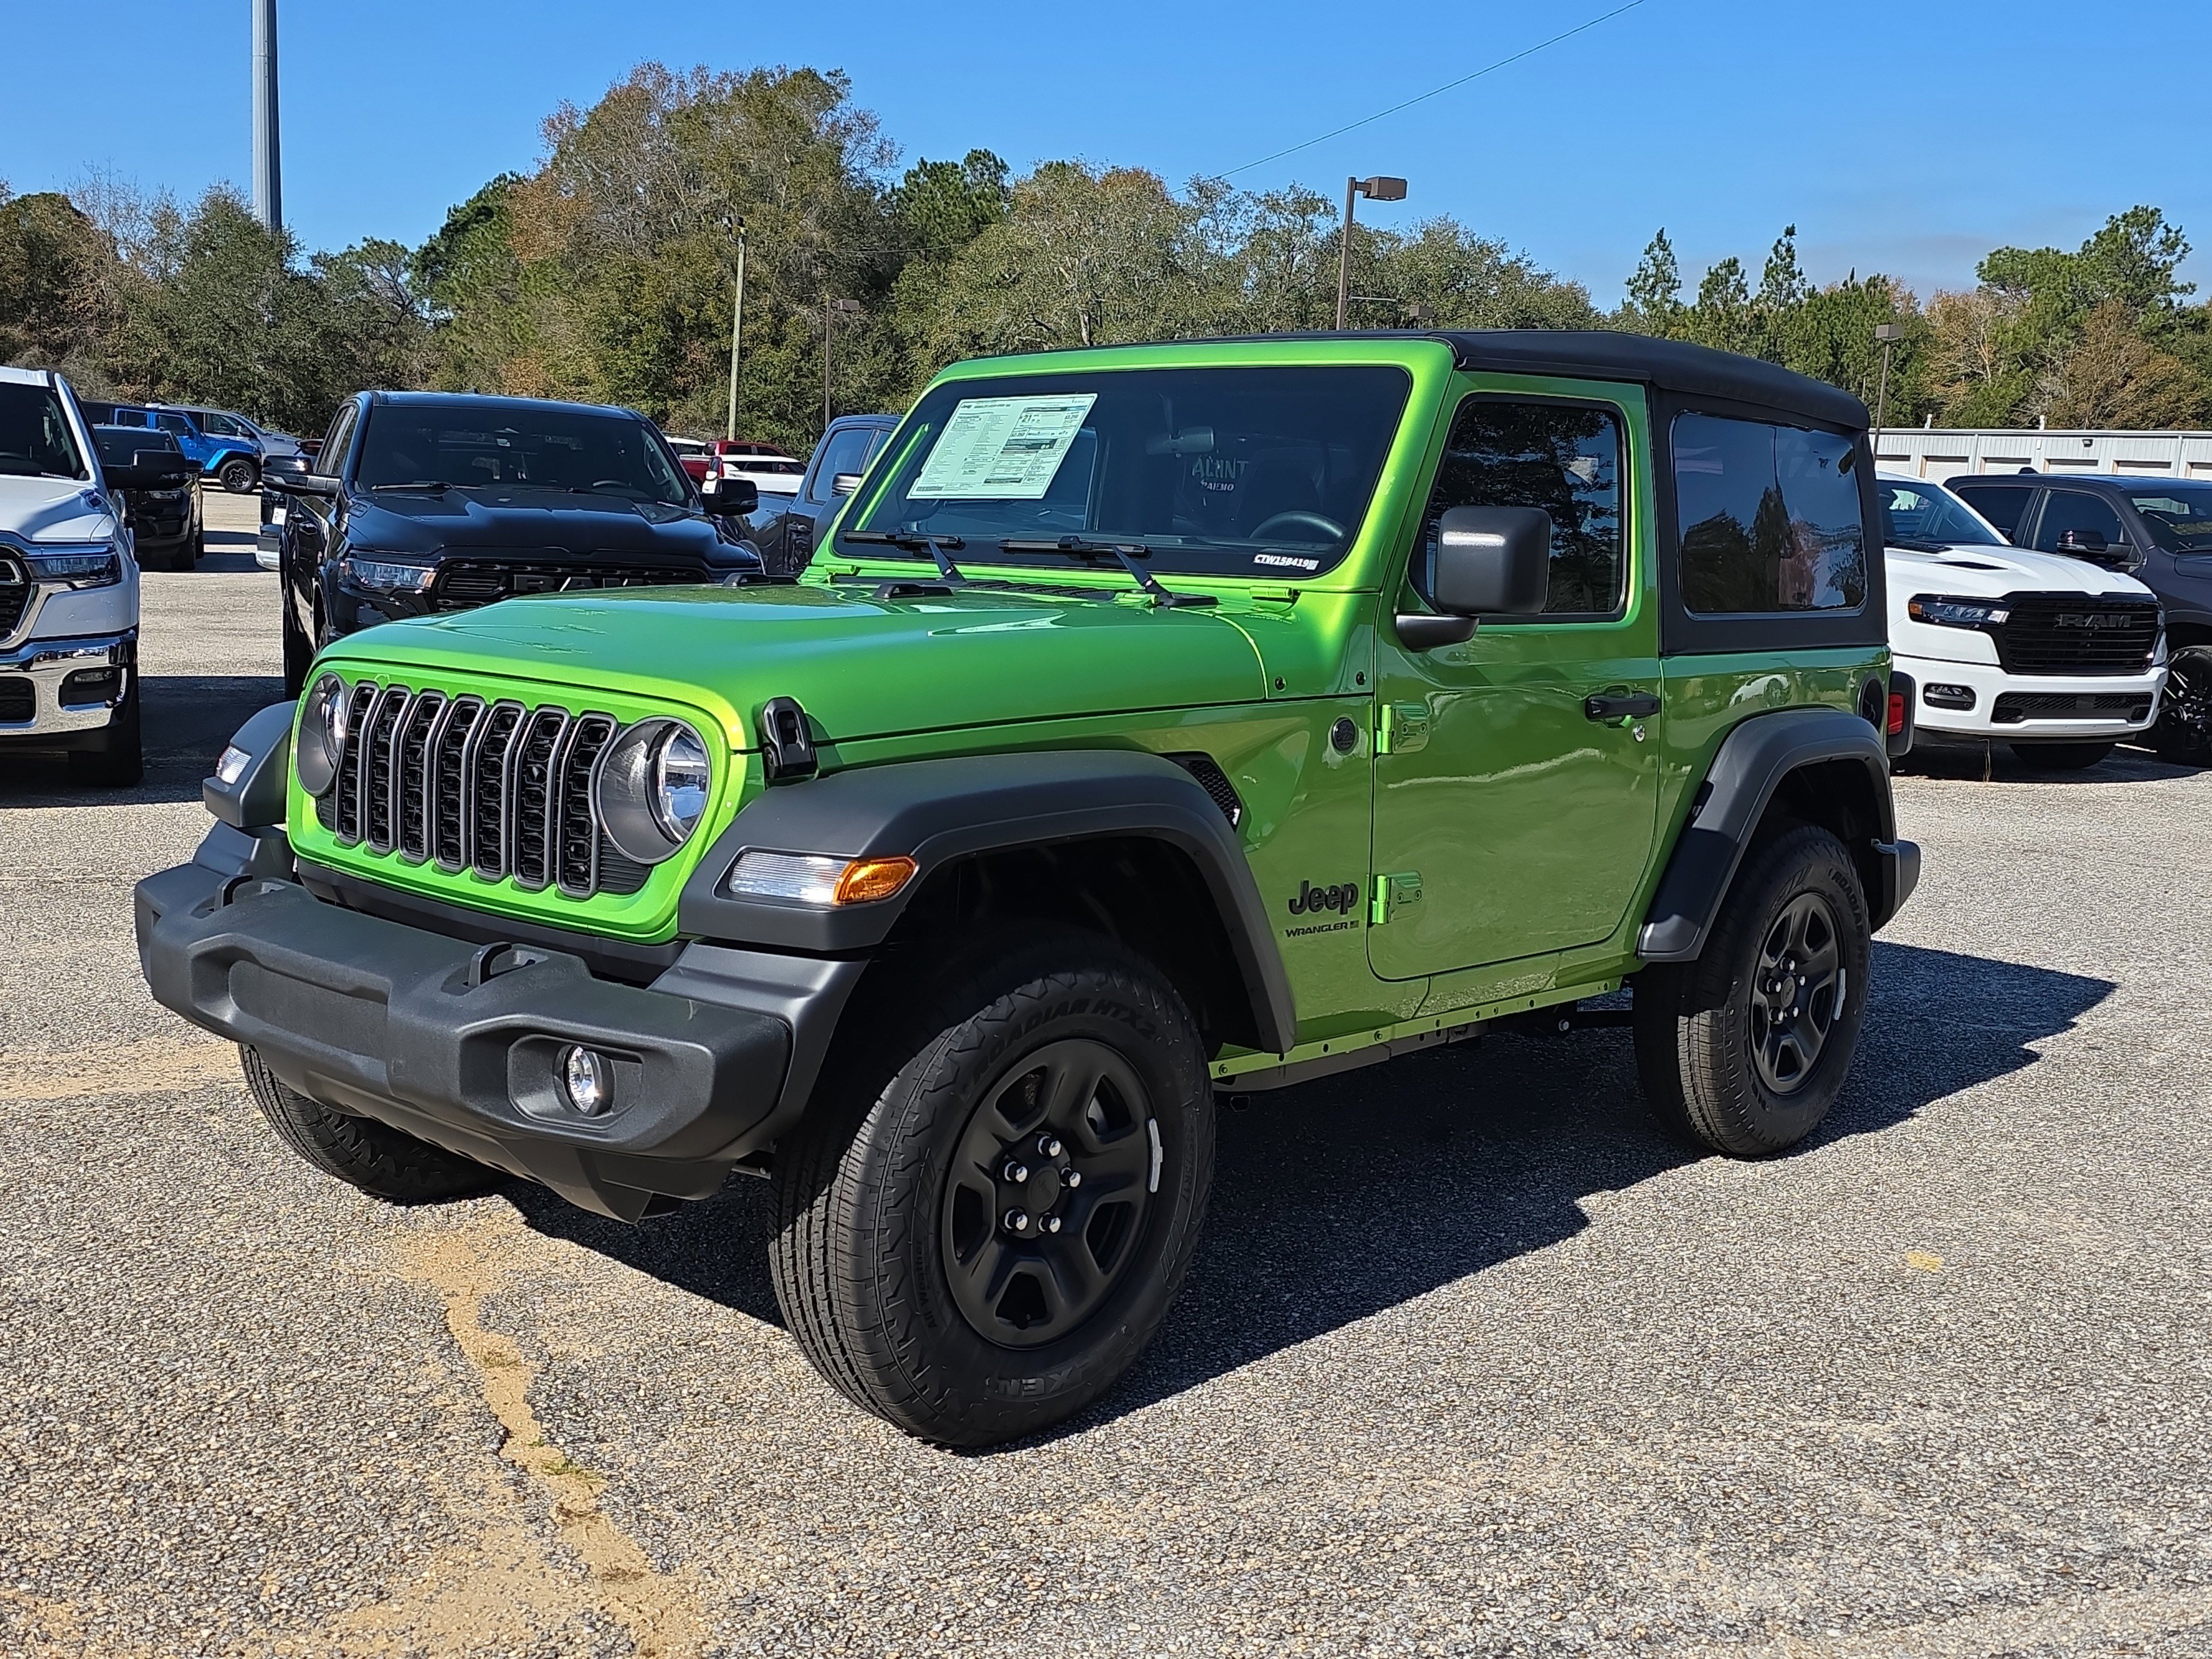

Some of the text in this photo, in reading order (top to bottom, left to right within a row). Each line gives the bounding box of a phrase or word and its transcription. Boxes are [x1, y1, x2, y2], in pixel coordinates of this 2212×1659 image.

[2059, 614, 2132, 627] RAM
[1288, 880, 1359, 915] Jeep
[1831, 871, 1865, 938] ROADIAN
[1285, 922, 1348, 938] WRANGLER
[974, 998, 1091, 1085] ROADIAN
